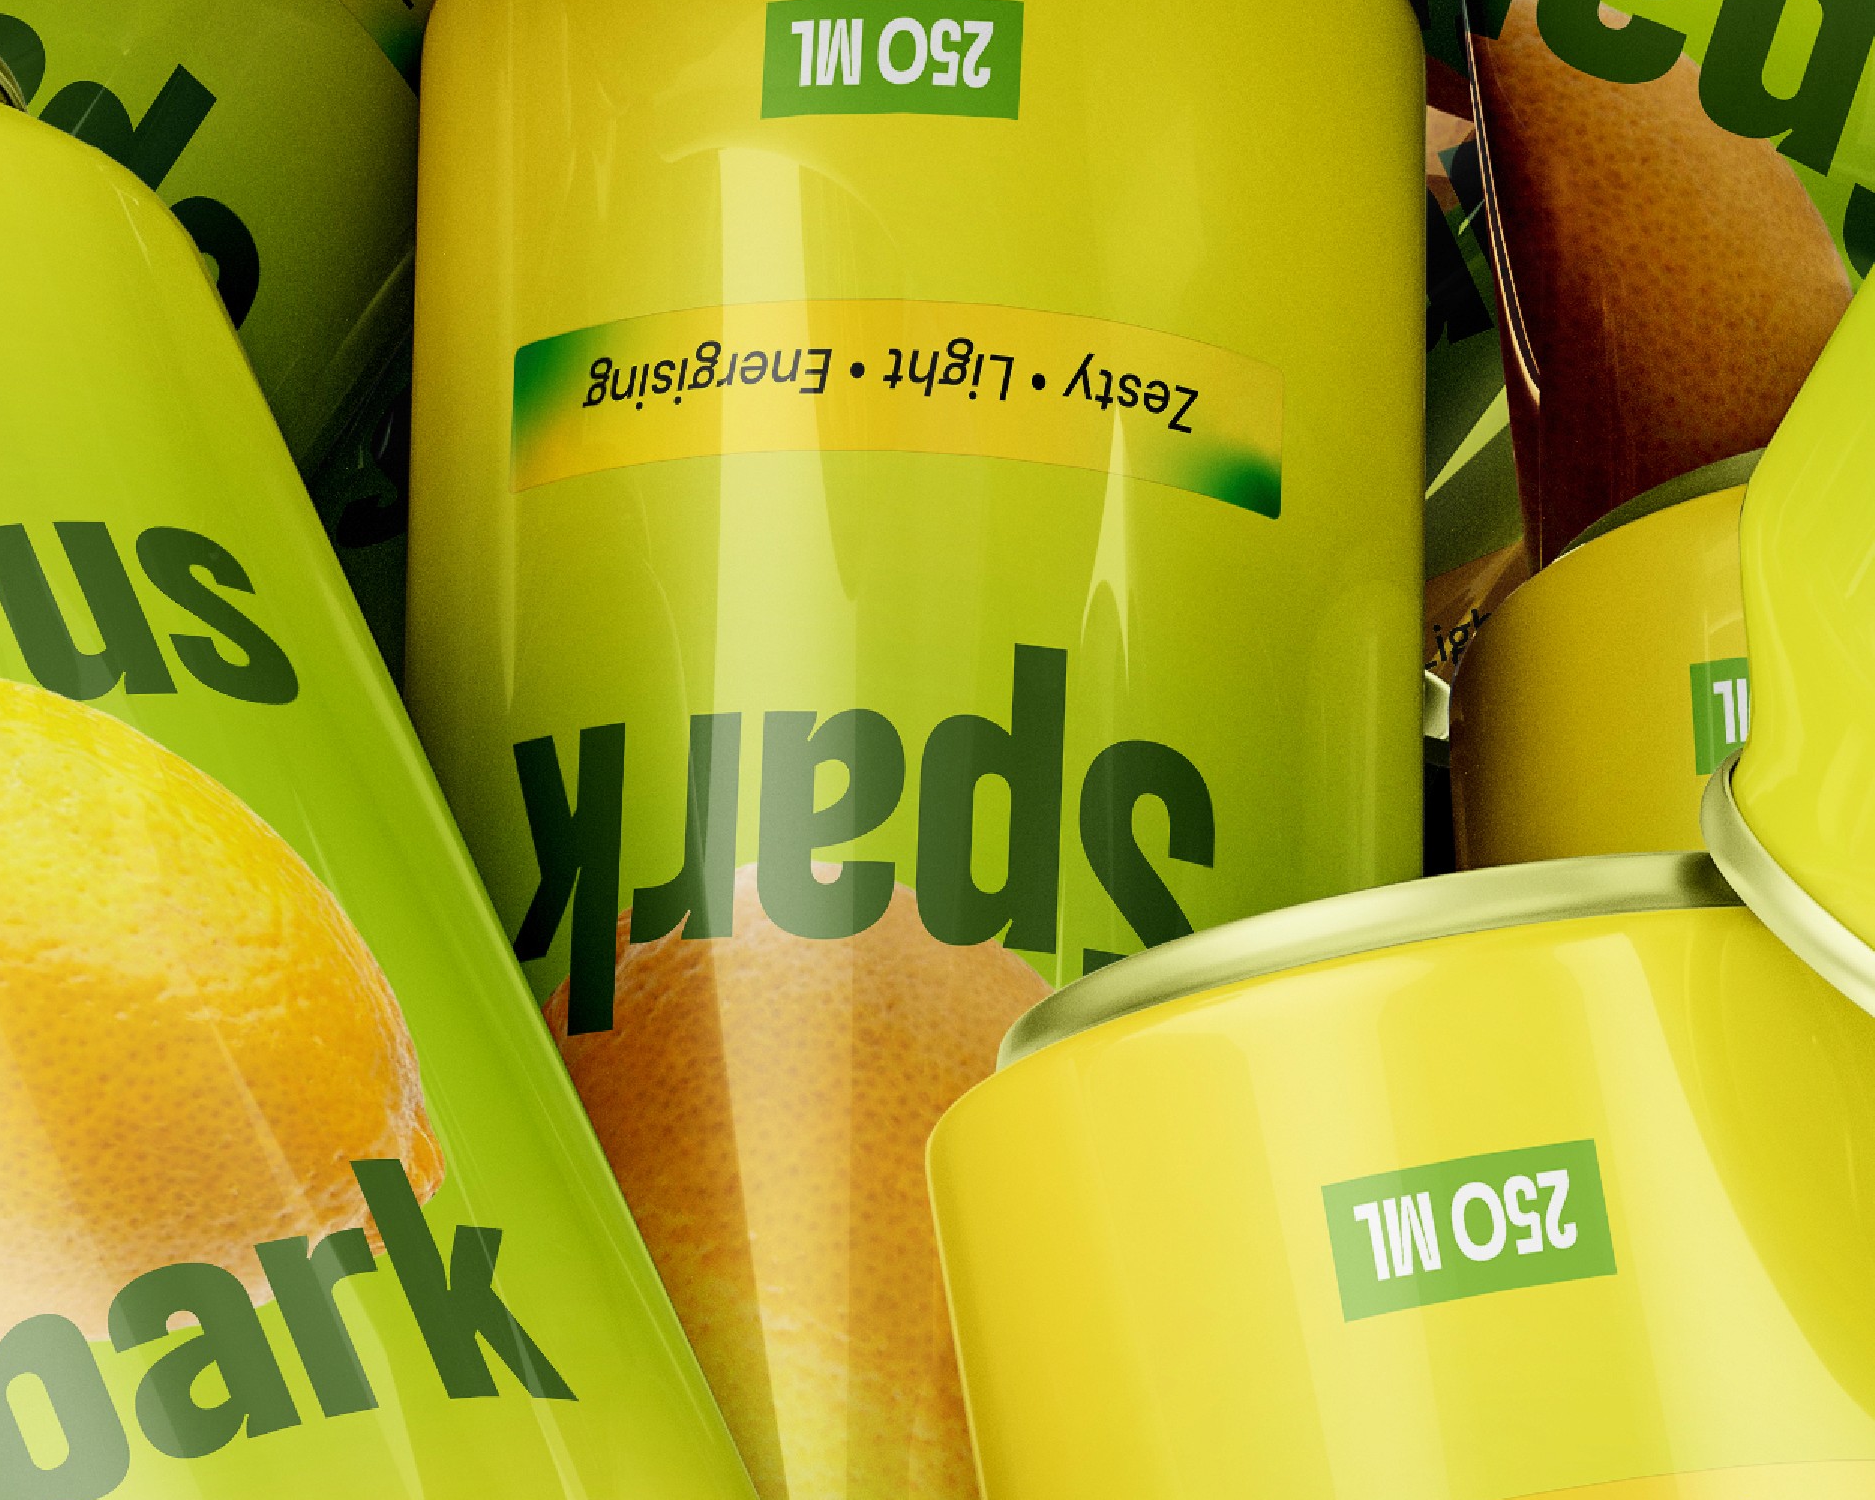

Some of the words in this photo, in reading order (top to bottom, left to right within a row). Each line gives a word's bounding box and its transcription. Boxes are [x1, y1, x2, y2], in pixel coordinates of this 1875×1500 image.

[791, 18, 862, 89] ML
[878, 15, 991, 89] 250
[581, 346, 833, 410] Energising
[883, 338, 1014, 404] Light
[1063, 352, 1199, 431] Zesty
[513, 644, 1215, 1037] Spark
[1354, 1188, 1441, 1282] ML
[1450, 1170, 1578, 1261] 250
